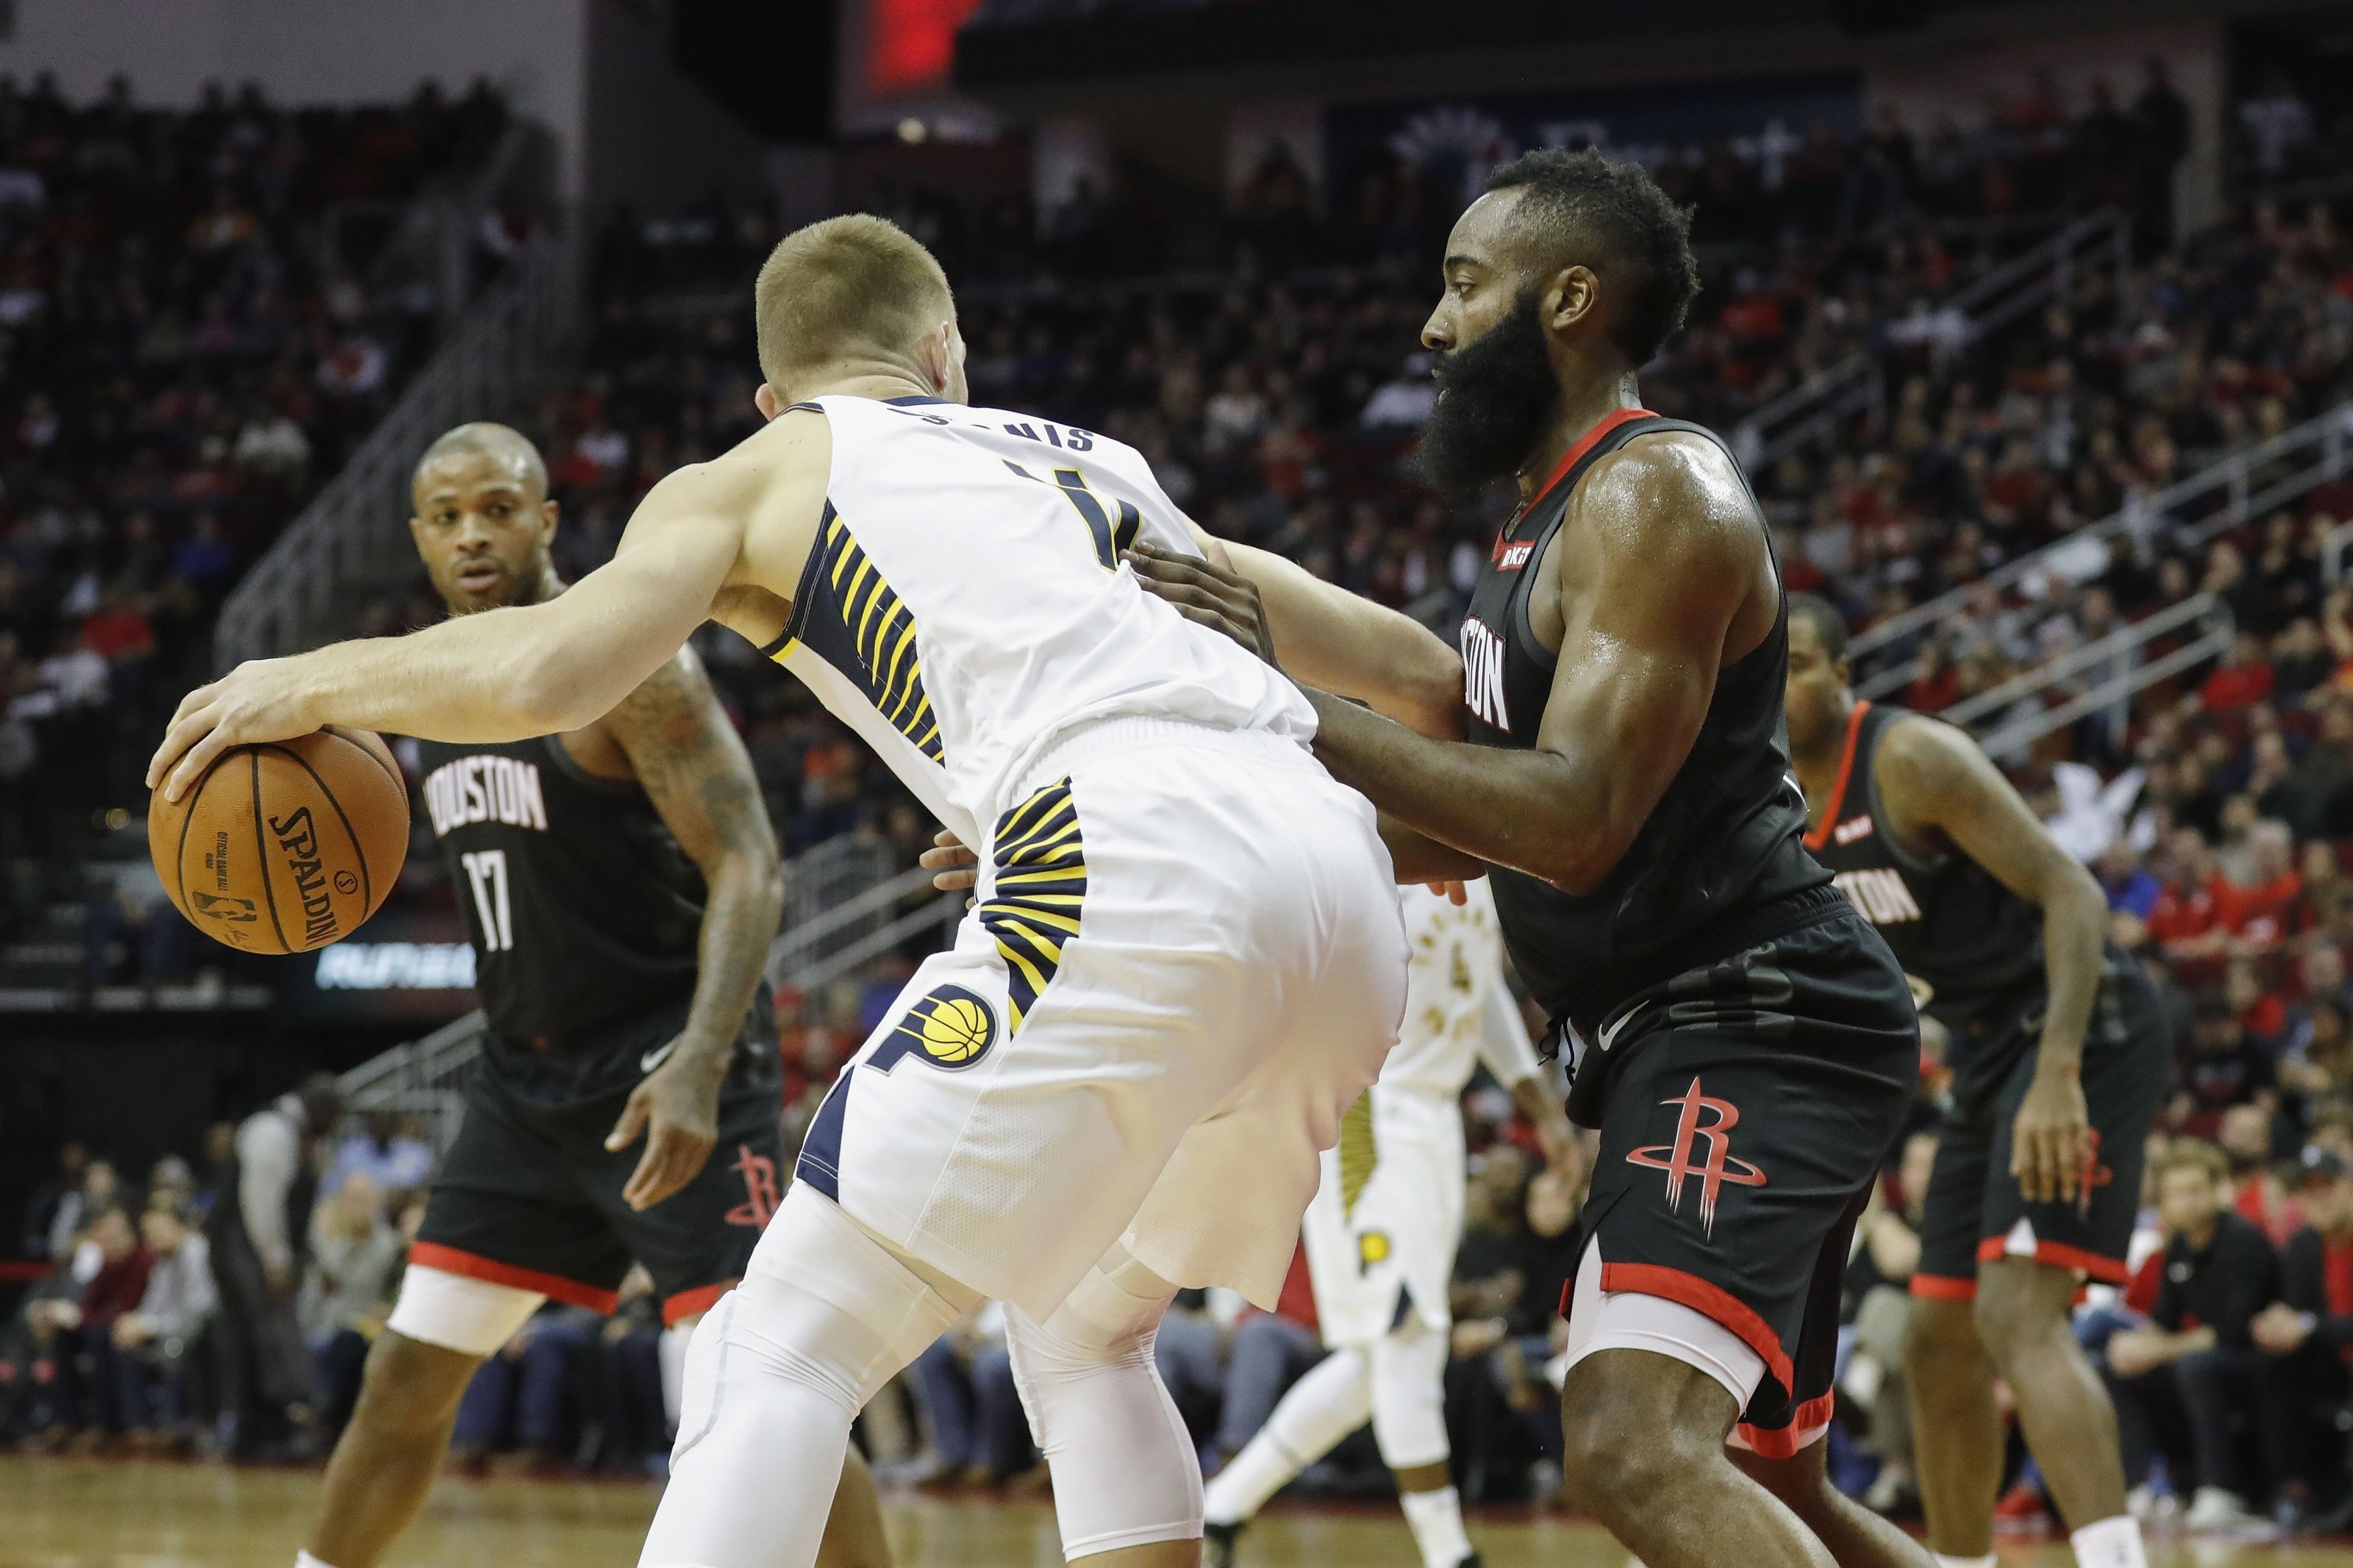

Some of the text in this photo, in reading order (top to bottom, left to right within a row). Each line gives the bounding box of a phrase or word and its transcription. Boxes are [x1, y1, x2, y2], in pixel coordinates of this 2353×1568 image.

[424, 755, 548, 837] OUSTON
[268, 806, 339, 944] SPALDIN
[461, 849, 513, 952] 17
